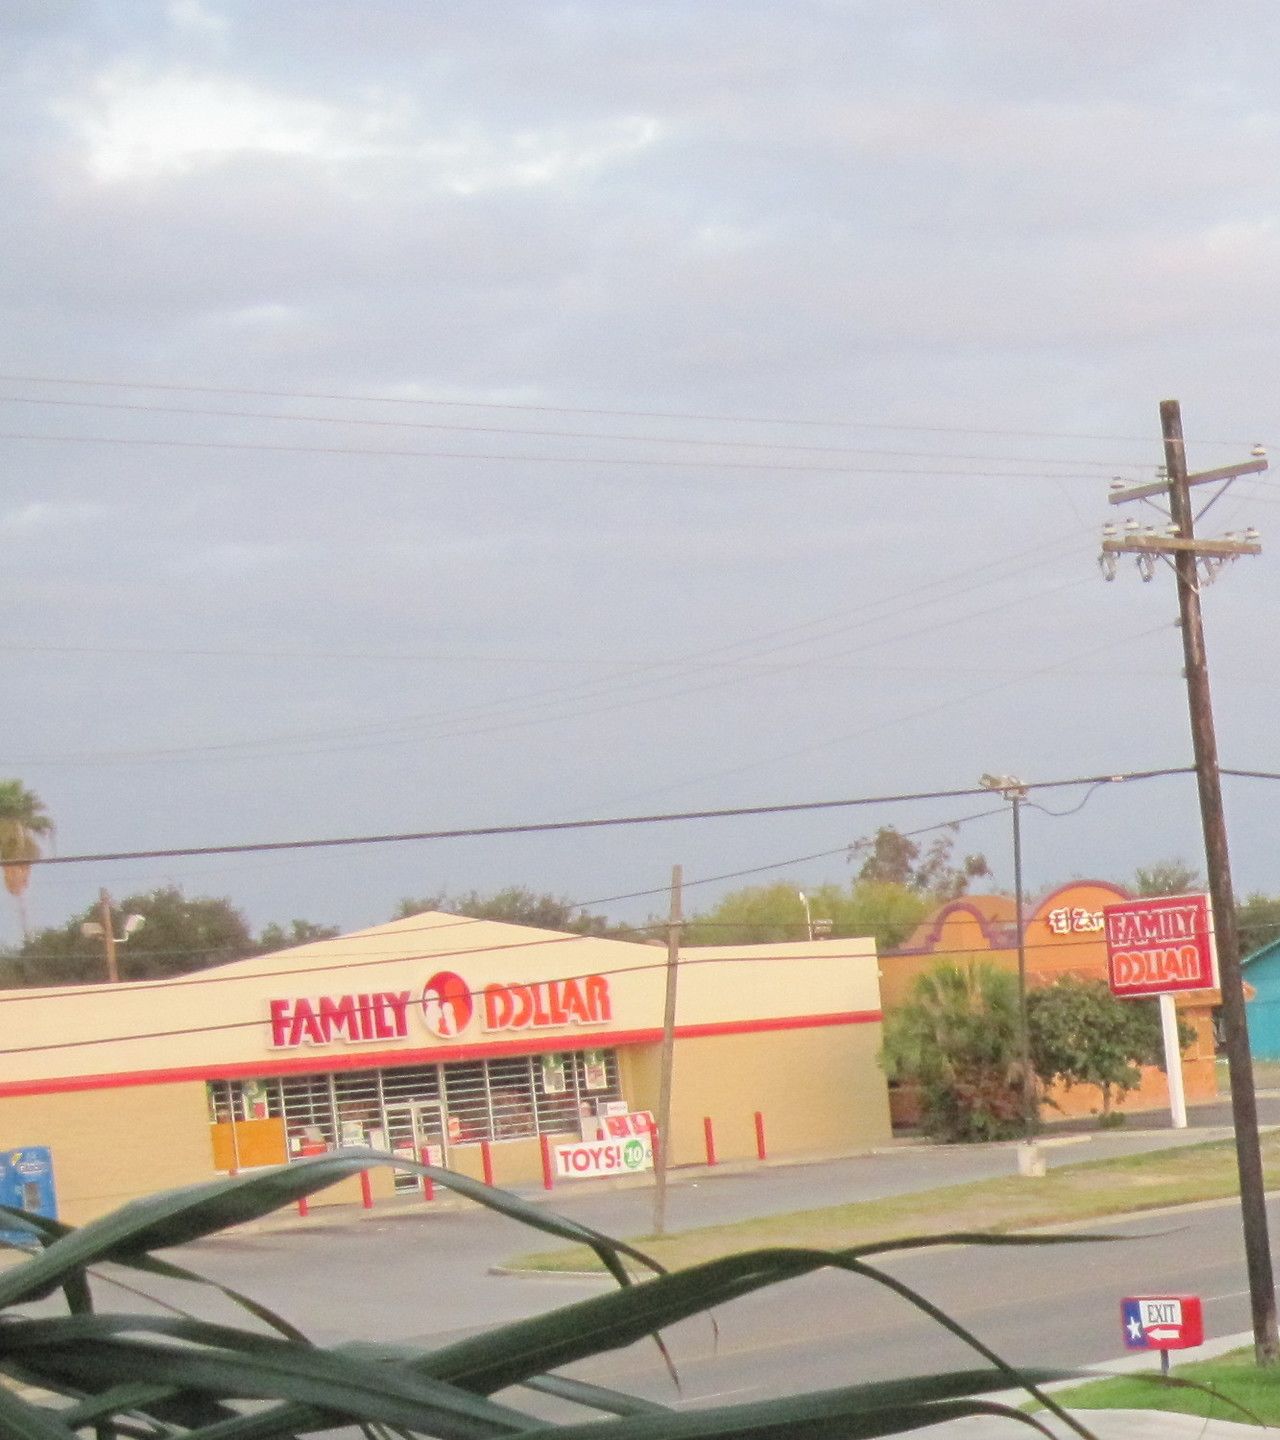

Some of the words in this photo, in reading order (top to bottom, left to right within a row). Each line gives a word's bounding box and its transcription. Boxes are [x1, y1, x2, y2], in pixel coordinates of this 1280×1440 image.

[1050, 907, 1071, 934] El
[1072, 908, 1104, 931] Zar
[1109, 905, 1199, 948] FAMILY
[1112, 945, 1200, 987] DOLLAR
[269, 990, 411, 1047] FAMILY
[482, 975, 613, 1032] DOLLAR
[559, 1145, 621, 1172] TOYS!
[1147, 1303, 1175, 1324] EXIT
